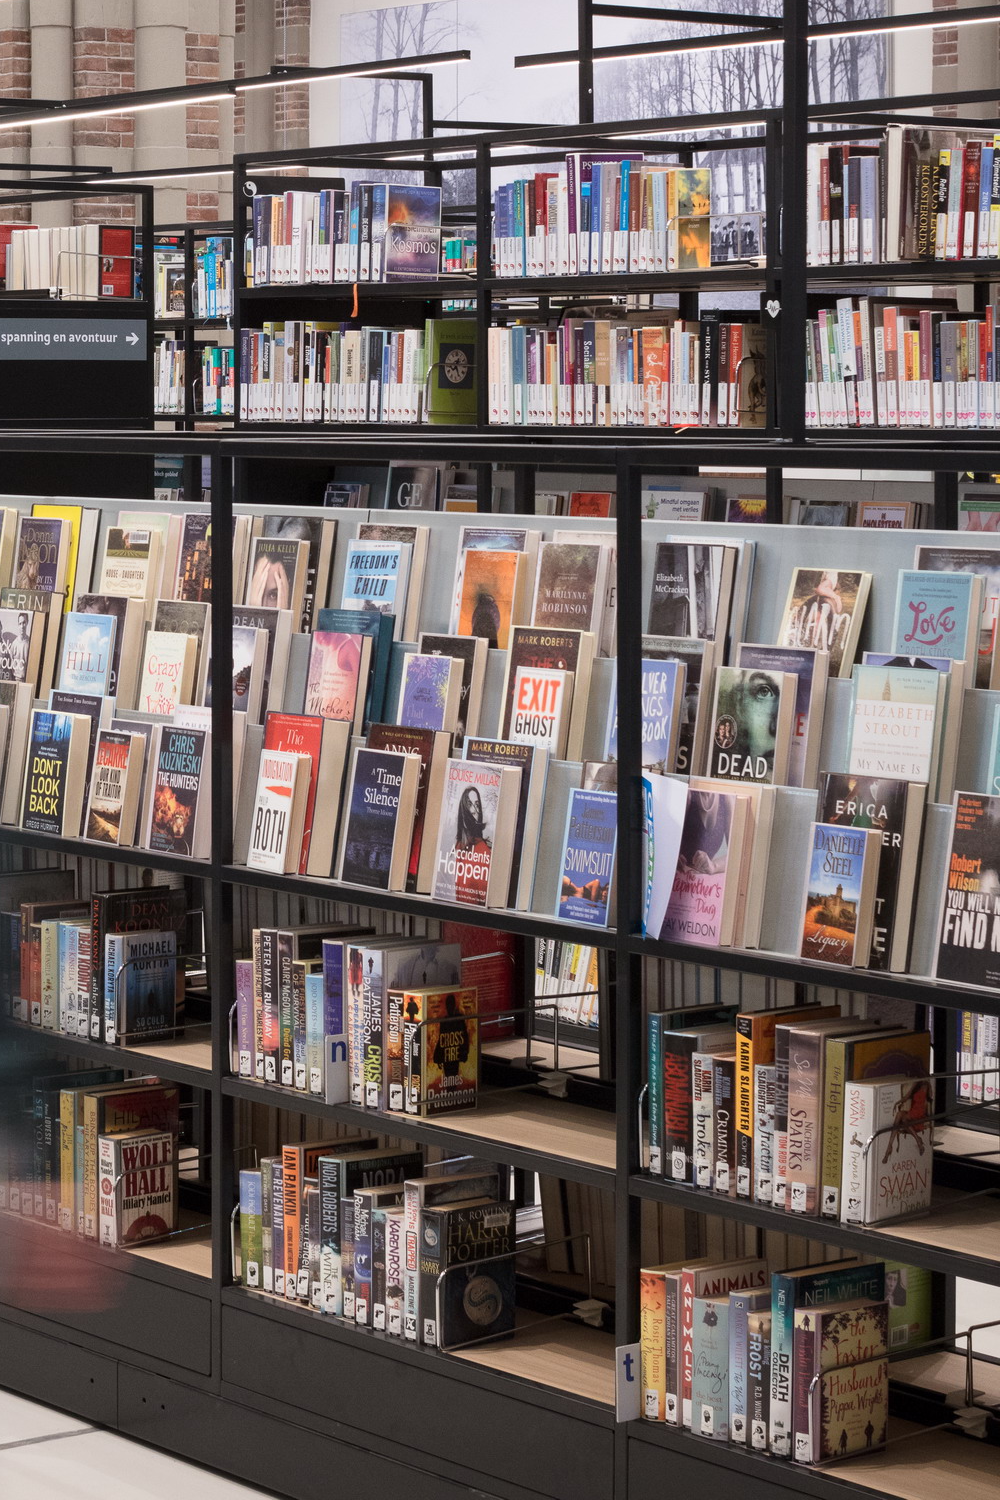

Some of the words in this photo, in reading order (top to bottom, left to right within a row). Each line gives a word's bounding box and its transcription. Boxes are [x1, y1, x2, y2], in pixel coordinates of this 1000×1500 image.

[939, 178, 947, 202] Religie
[919, 165, 930, 255] KLOOSTERORDEN
[390, 236, 437, 255] Kosmos
[0, 330, 51, 346] spanning
[53, 333, 67, 342] en
[69, 331, 118, 343] avontuur
[583, 341, 592, 369] Sociale
[680, 499, 699, 507] omgaan
[258, 542, 276, 553] JULIA
[277, 543, 296, 554] KELLY
[350, 554, 398, 570] FREEDOM'S
[354, 575, 388, 597] CHILD
[655, 584, 688, 594] McCracken
[656, 573, 684, 583] Elizabeth
[7, 592, 43, 610] ERIN
[545, 589, 587, 601] MARILYNNE
[541, 602, 588, 615] ROBINSON
[904, 600, 956, 646] Love
[518, 635, 538, 647] MARK
[539, 636, 573, 648] ROBERTS
[66, 651, 106, 674] HILL
[148, 655, 182, 683] Crazy
[155, 678, 164, 693] in
[518, 676, 561, 713] EXIT
[308, 699, 350, 718] Mother's
[856, 703, 934, 722] ELIZABETH
[515, 712, 555, 738] GHOST
[864, 723, 921, 739] STROUT
[169, 733, 196, 753] CHRIS
[471, 741, 493, 753] MARK
[494, 743, 529, 758] ROBERTS
[33, 756, 62, 775] DON'T
[159, 750, 201, 774] KUZNESKI
[261, 758, 292, 782] INDIGNATION
[717, 752, 768, 780] DEAD
[31, 775, 60, 798] LOOK
[158, 770, 169, 786] THE
[169, 772, 198, 791] HUNTERS
[376, 767, 402, 787] Time
[449, 767, 473, 784] LOUISE
[474, 770, 499, 788] MILLAR
[29, 796, 58, 816] BACK
[363, 787, 399, 808] Silence
[835, 799, 889, 820] ERICA
[253, 807, 286, 854] ROTH
[815, 828, 865, 857] DANIELLE
[449, 845, 490, 865] Accidents
[564, 847, 612, 877] SWIMSUIT
[822, 851, 854, 877] STEEL
[951, 852, 982, 875] Robert
[437, 856, 489, 884] Happen
[949, 871, 980, 892] Wilson
[131, 903, 169, 916] DEAN
[948, 889, 964, 908] YOU
[115, 916, 187, 933] KOONTZ
[679, 920, 716, 937] WELDON
[108, 939, 116, 967] MICHAEL
[130, 940, 173, 958] MICHAEL
[264, 935, 272, 967] PETER
[807, 931, 849, 956] Legacy
[77, 957, 91, 994] KOONTZ
[264, 968, 272, 988] MAY
[281, 956, 291, 983] CLAIRE
[264, 992, 273, 1039] RUNAWAY
[282, 984, 291, 1026] McGOWAN
[362, 976, 372, 1044] PATTERSON
[371, 991, 382, 1032] JAMES
[389, 996, 403, 1043] Patterson
[440, 1030, 465, 1048] CROSS
[331, 1040, 347, 1063] n
[444, 1046, 460, 1063] FIRE
[740, 1041, 750, 1072] KARIN
[439, 1073, 464, 1089] James
[694, 1059, 702, 1102] SLAUGHTER
[702, 1070, 712, 1093] KARIN
[664, 1052, 690, 1142] ABOMINABLE
[740, 1075, 750, 1131] SLAUGHTER
[826, 1081, 841, 1114] Help
[849, 1089, 859, 1127] SWAN
[788, 1107, 807, 1172] SPARKS
[804, 1121, 813, 1162] NICHOLAS
[123, 1140, 172, 1170] WOLF
[284, 1150, 296, 1172] IAN
[892, 1158, 917, 1172] KAREN
[125, 1166, 170, 1198] HALL
[323, 1162, 337, 1188] NORA
[879, 1168, 928, 1197] SWAN
[123, 1195, 146, 1211] Hilary
[146, 1192, 172, 1207] Mantel
[273, 1178, 283, 1231] REVENANT
[284, 1174, 296, 1217] RANKIN
[322, 1192, 338, 1234] ROBERTS
[407, 1233, 417, 1270] TRAPPED
[448, 1237, 511, 1264] POTTER
[703, 1269, 766, 1297] ANIMALS
[804, 1287, 835, 1305] NEIL
[836, 1278, 879, 1298] WHITE
[777, 1289, 785, 1308] NEIL
[683, 1281, 693, 1382] ANIMALS
[623, 1352, 635, 1382] t
[652, 1346, 663, 1384] Thomas
[750, 1331, 762, 1380] FROST
[771, 1351, 779, 1400] COLLECTOR
[778, 1353, 790, 1403] DEATH
[829, 1363, 885, 1397] Husband
